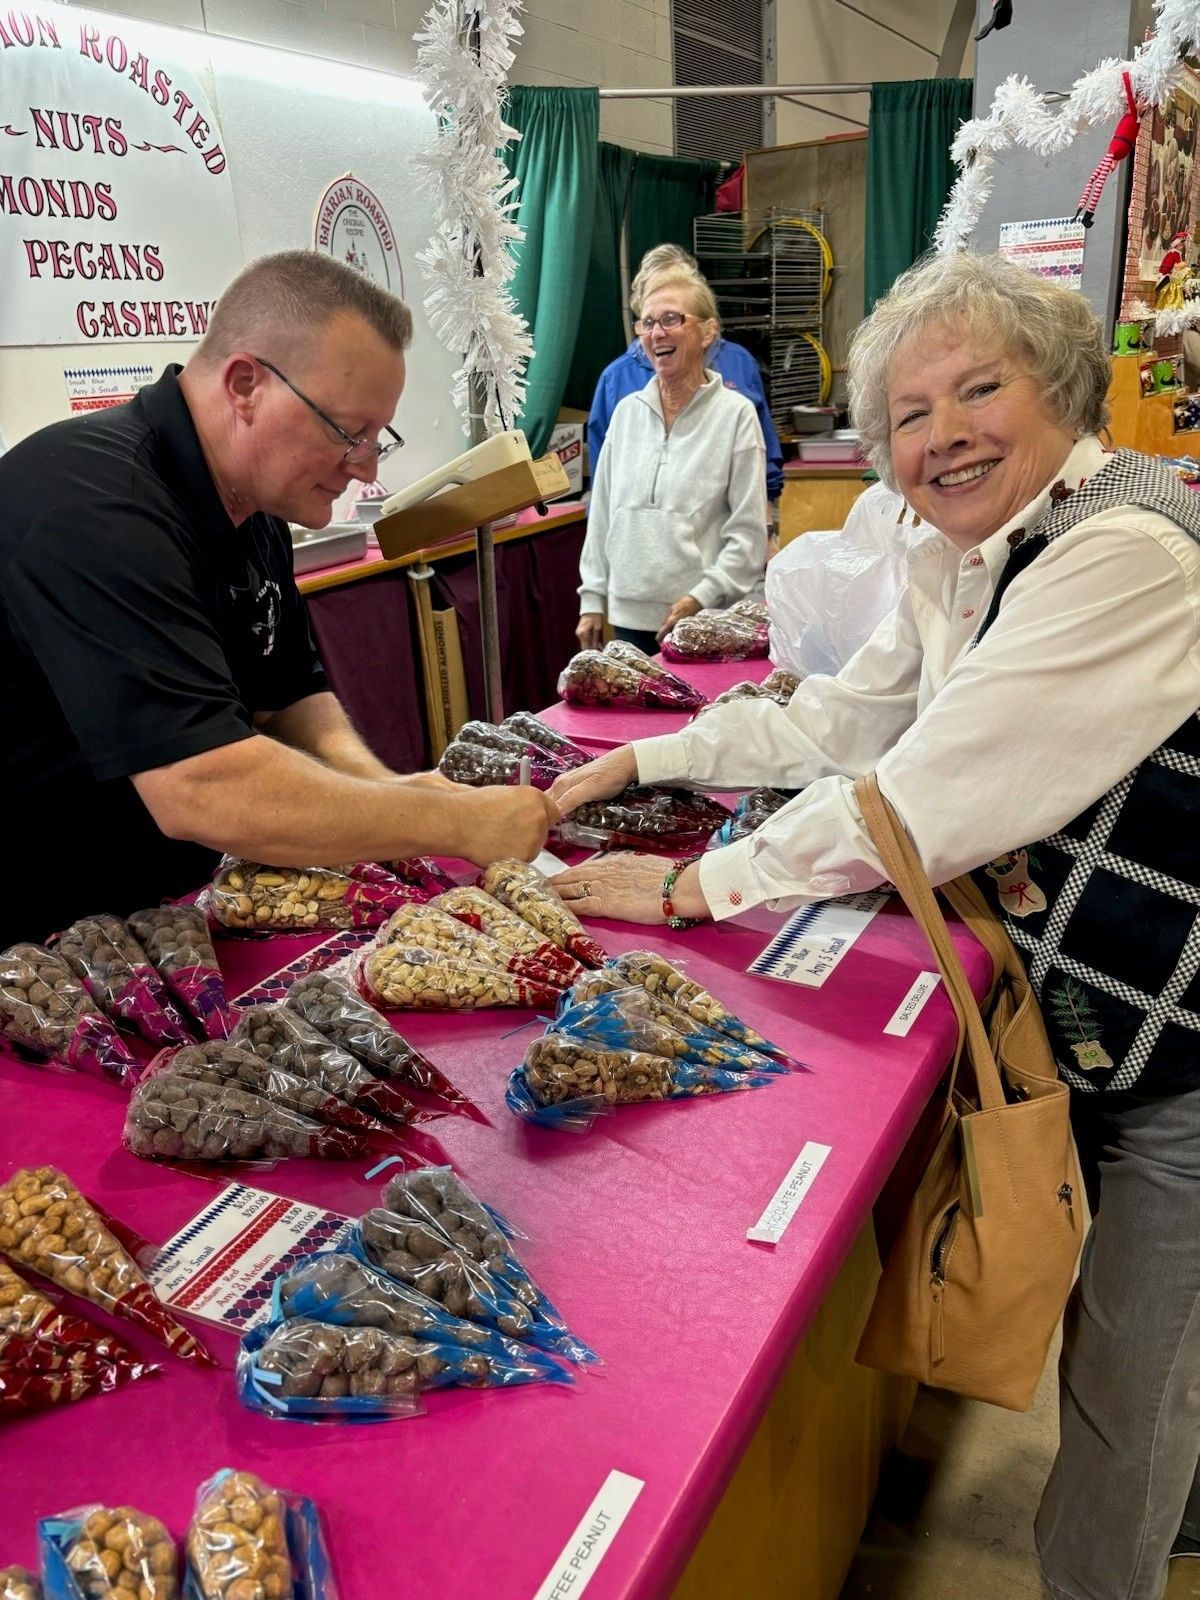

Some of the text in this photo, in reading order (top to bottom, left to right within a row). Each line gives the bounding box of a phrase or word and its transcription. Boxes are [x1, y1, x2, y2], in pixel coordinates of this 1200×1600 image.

[80, 23, 226, 175] ROASTED
[30, 107, 128, 157] NUTS
[319, 185, 393, 252] BAVARIAN ROASTED
[23, 239, 164, 282] PECANS
[77, 301, 217, 338] CASHEW
[72, 387, 88, 396] Any
[98, 385, 119, 393] Small
[434, 620, 448, 667] ALMONDS
[776, 963, 799, 979] Small
[791, 948, 811, 961] Blue
[818, 954, 834, 962] 5
[821, 937, 848, 955] Small
[805, 961, 833, 977] Any
[899, 983, 929, 1021] SALTED DELUXE
[789, 1160, 813, 1191] PEANUT
[165, 1273, 188, 1291] Any
[189, 1246, 216, 1267] Small
[241, 1195, 270, 1218] $20.00
[191, 1206, 303, 1312] Medium Red $8.00
[216, 1210, 318, 1308] Any 3 Medium $20.00
[163, 1259, 182, 1274] Blue
[569, 1510, 611, 1571] PEANUT
